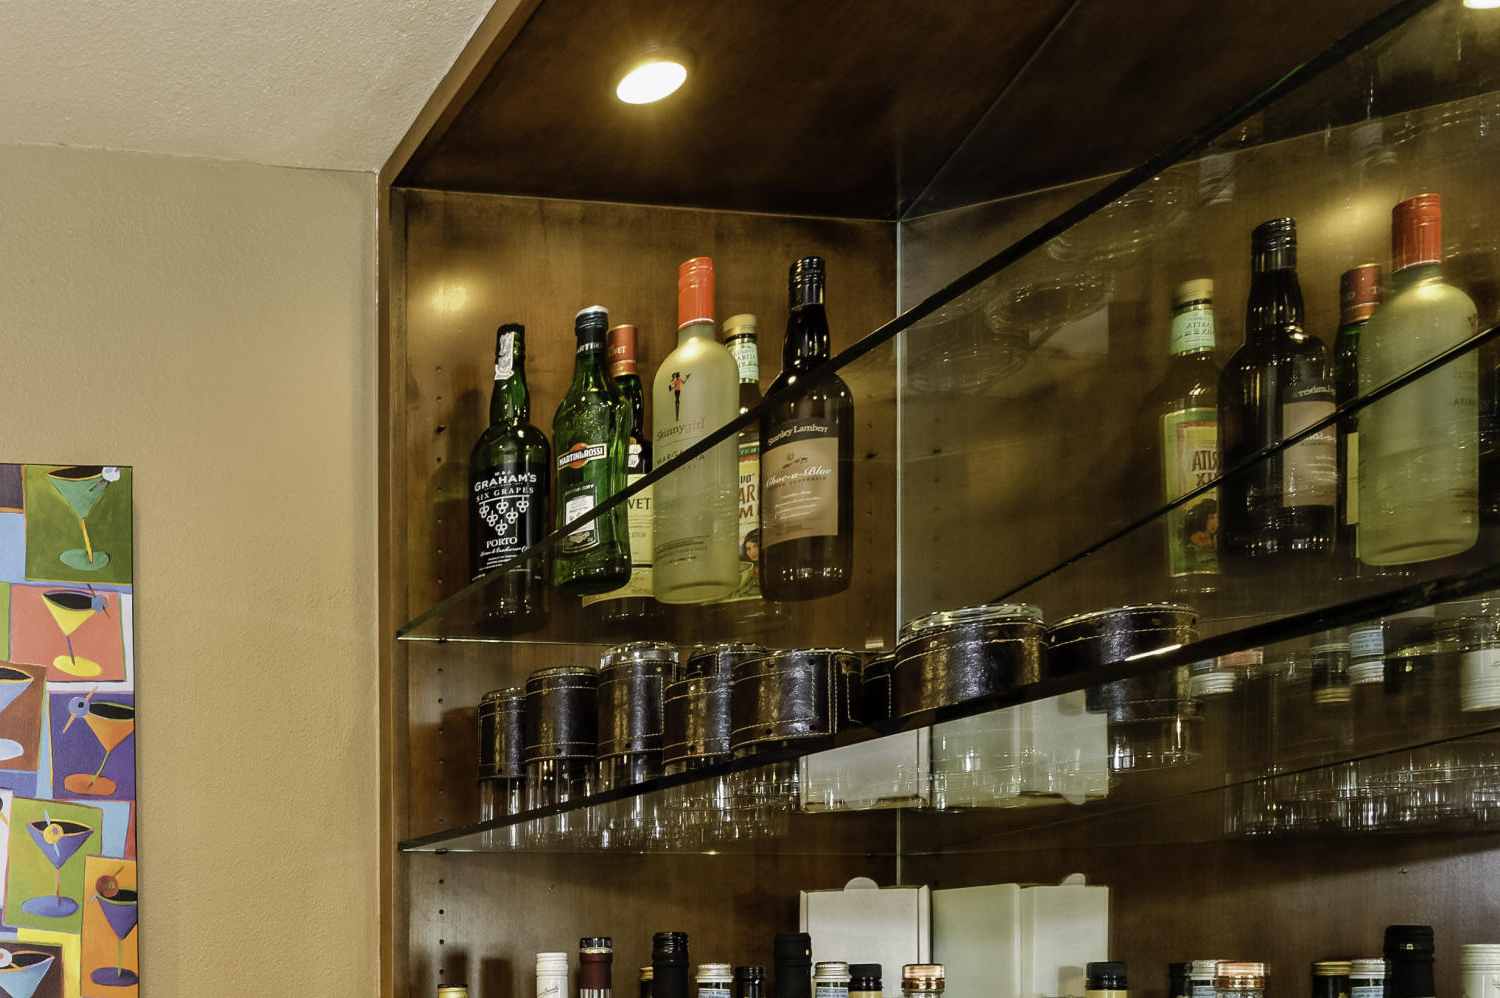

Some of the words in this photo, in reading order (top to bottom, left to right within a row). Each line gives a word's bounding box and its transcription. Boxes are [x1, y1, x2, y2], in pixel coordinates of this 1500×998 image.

[793, 424, 828, 433] Lambert
[475, 472, 537, 492] GRAHAM'S
[476, 493, 490, 503] SIX
[494, 487, 534, 496] GRAPES
[486, 537, 518, 548] PORTO
